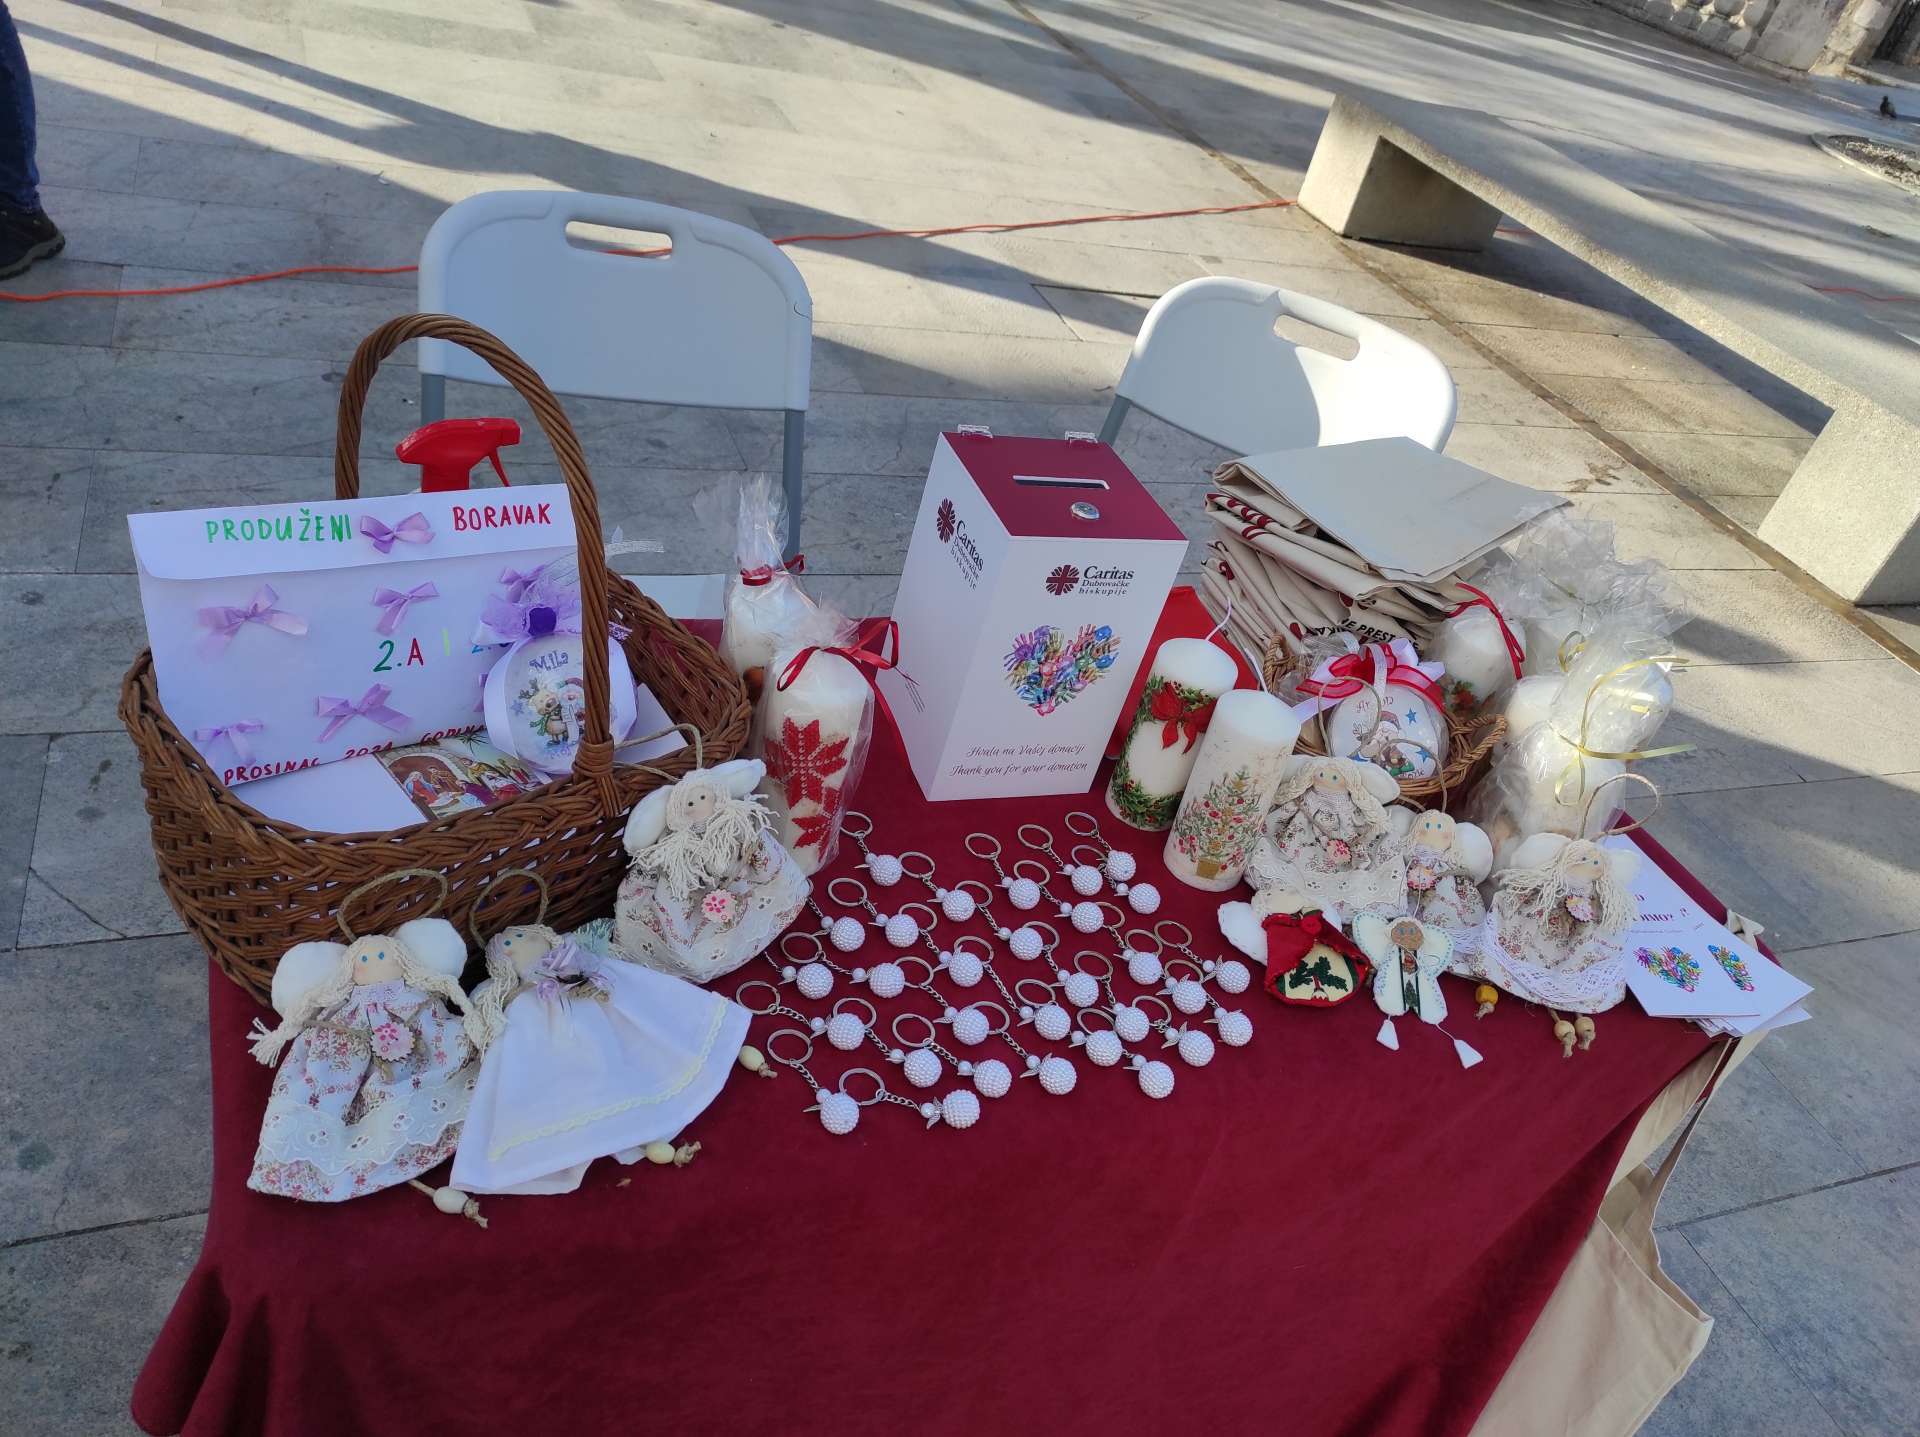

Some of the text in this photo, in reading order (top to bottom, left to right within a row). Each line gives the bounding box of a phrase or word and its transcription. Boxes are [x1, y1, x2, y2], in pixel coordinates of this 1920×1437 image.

[206, 503, 551, 543] PRODUŽENI BORAVAK
[956, 519, 984, 572] Caritas
[1083, 565, 1135, 580] Caritas
[1078, 587, 1128, 597] biskupije
[1081, 579, 1131, 588] Dubrovačke
[373, 638, 424, 673] 2.A
[528, 650, 569, 671] Mila
[966, 745, 1000, 757] Hvala
[1002, 747, 1017, 756] na
[224, 757, 320, 786] PROSINAC
[950, 760, 1088, 777] Thank you for your donation
